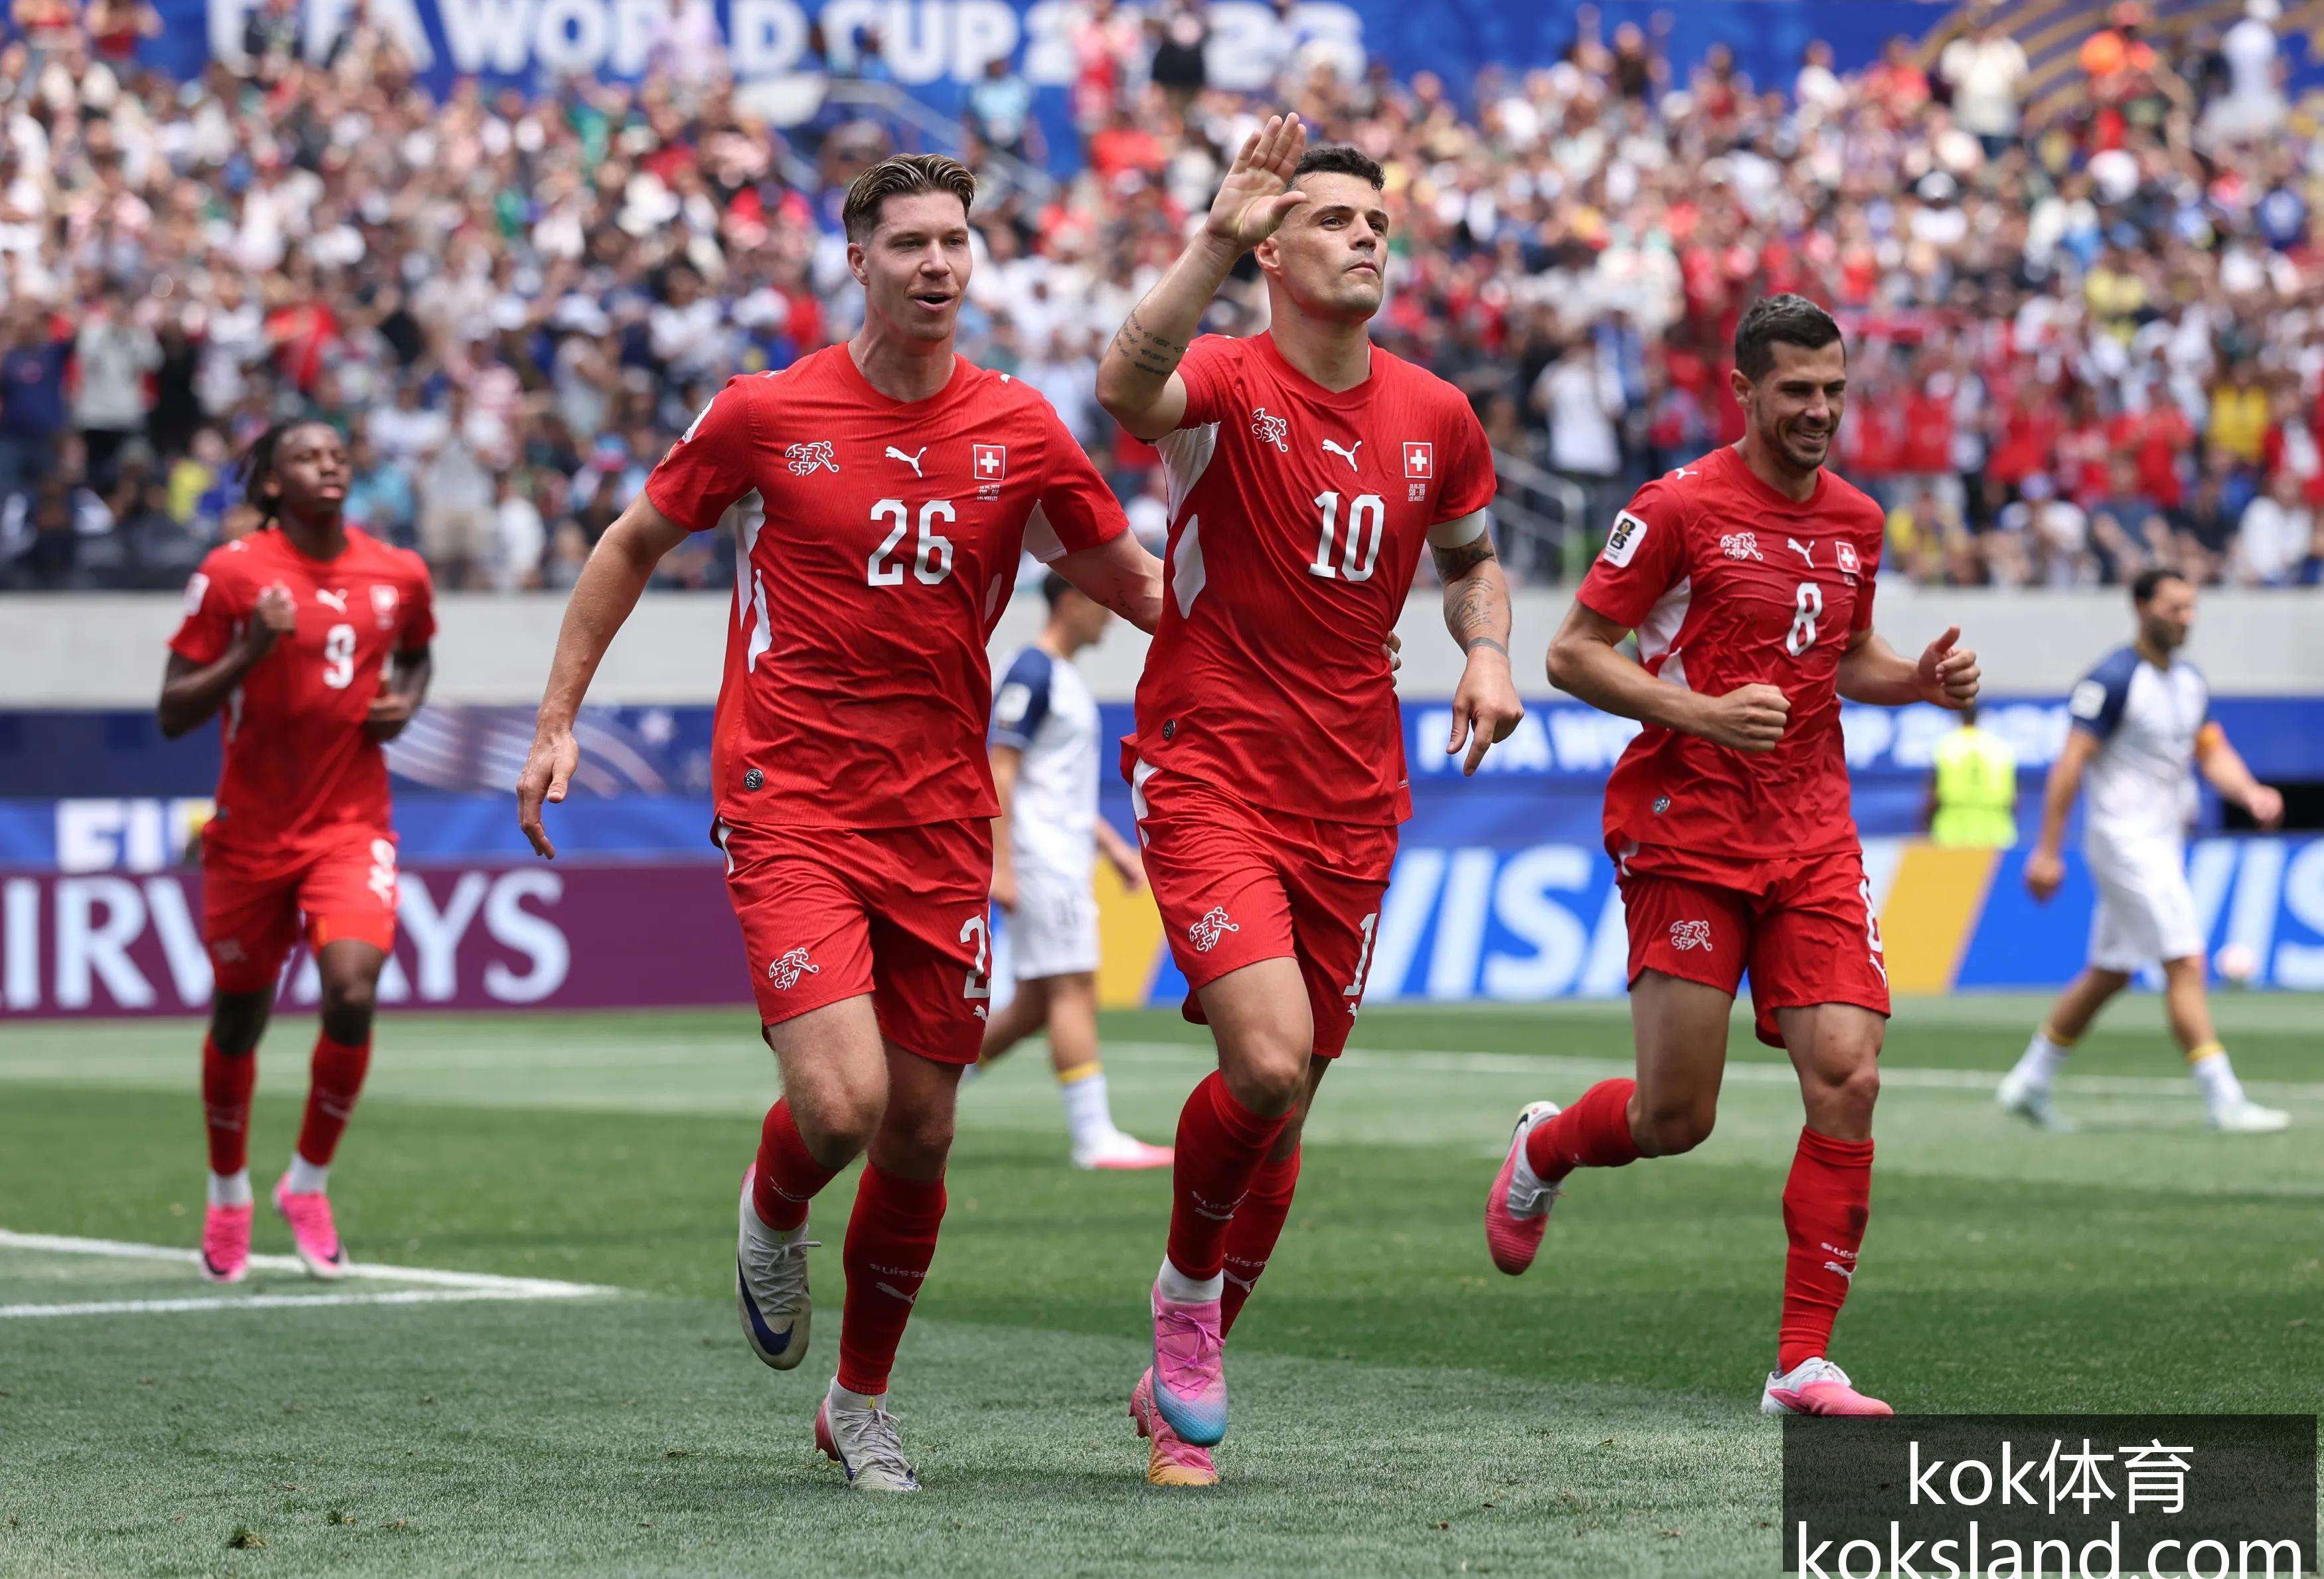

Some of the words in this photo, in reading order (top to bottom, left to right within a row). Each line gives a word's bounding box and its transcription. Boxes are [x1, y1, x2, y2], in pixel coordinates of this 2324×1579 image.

[868, 499, 956, 586] 26
[1309, 491, 1385, 582] 10
[323, 623, 357, 689] 9
[1786, 582, 1823, 657] 8
